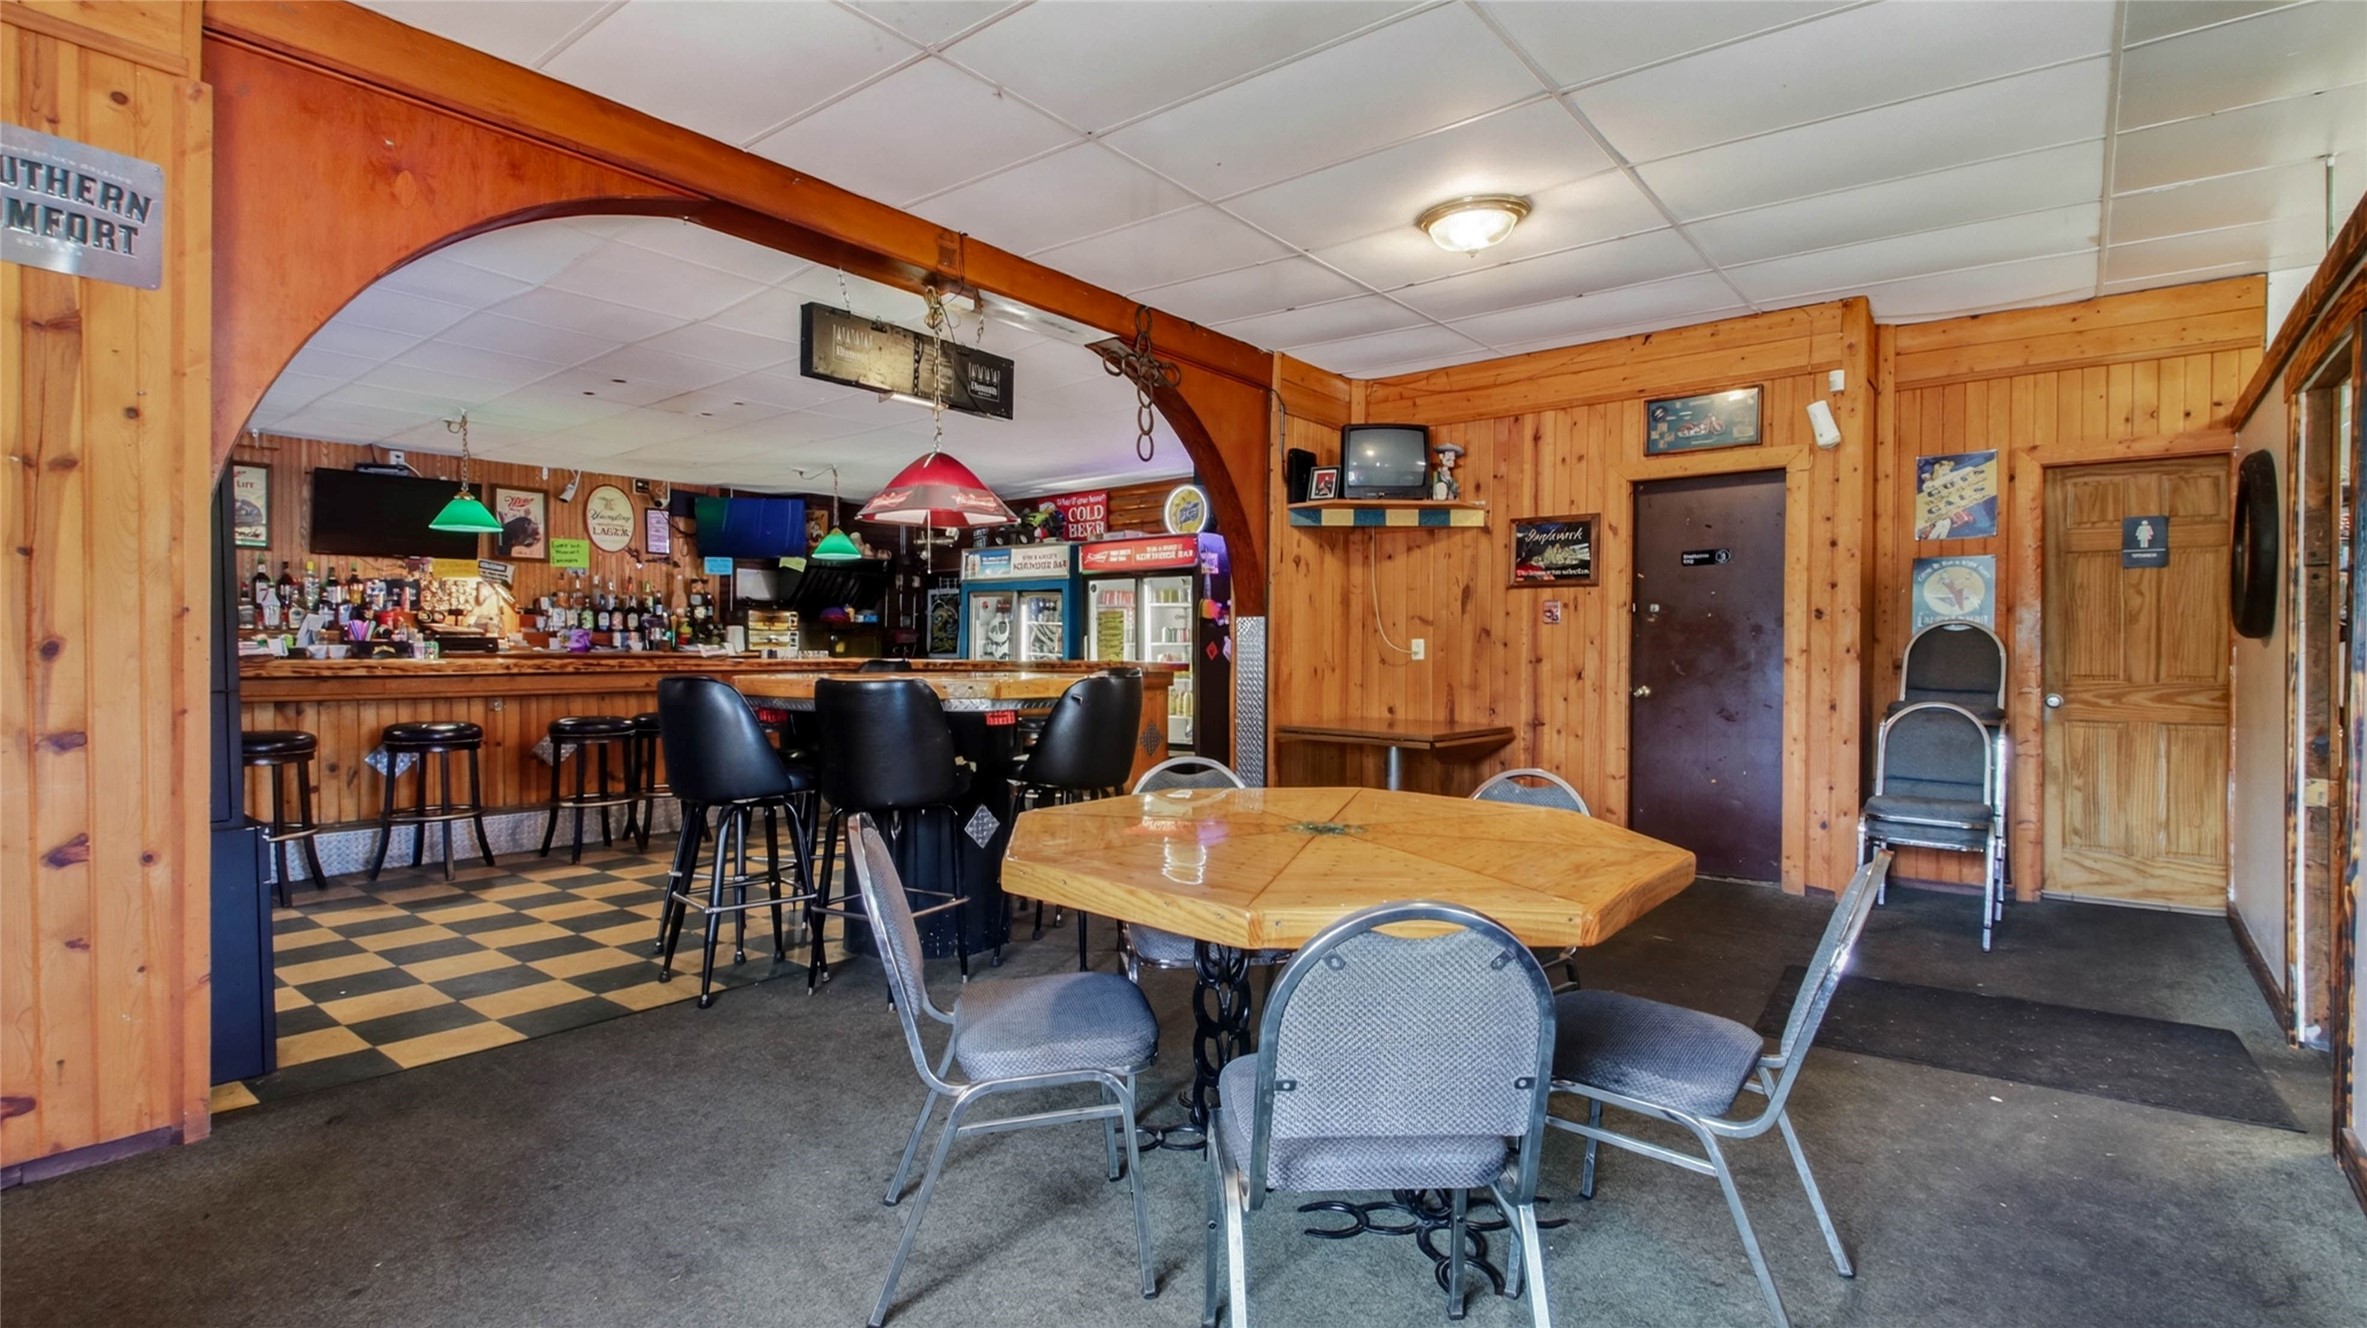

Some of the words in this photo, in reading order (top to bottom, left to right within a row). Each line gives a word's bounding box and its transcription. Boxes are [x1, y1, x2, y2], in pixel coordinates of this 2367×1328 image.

[1068, 504, 1104, 522] COLD
[592, 526, 630, 537] LAGER
[1068, 520, 1104, 538] BEER
